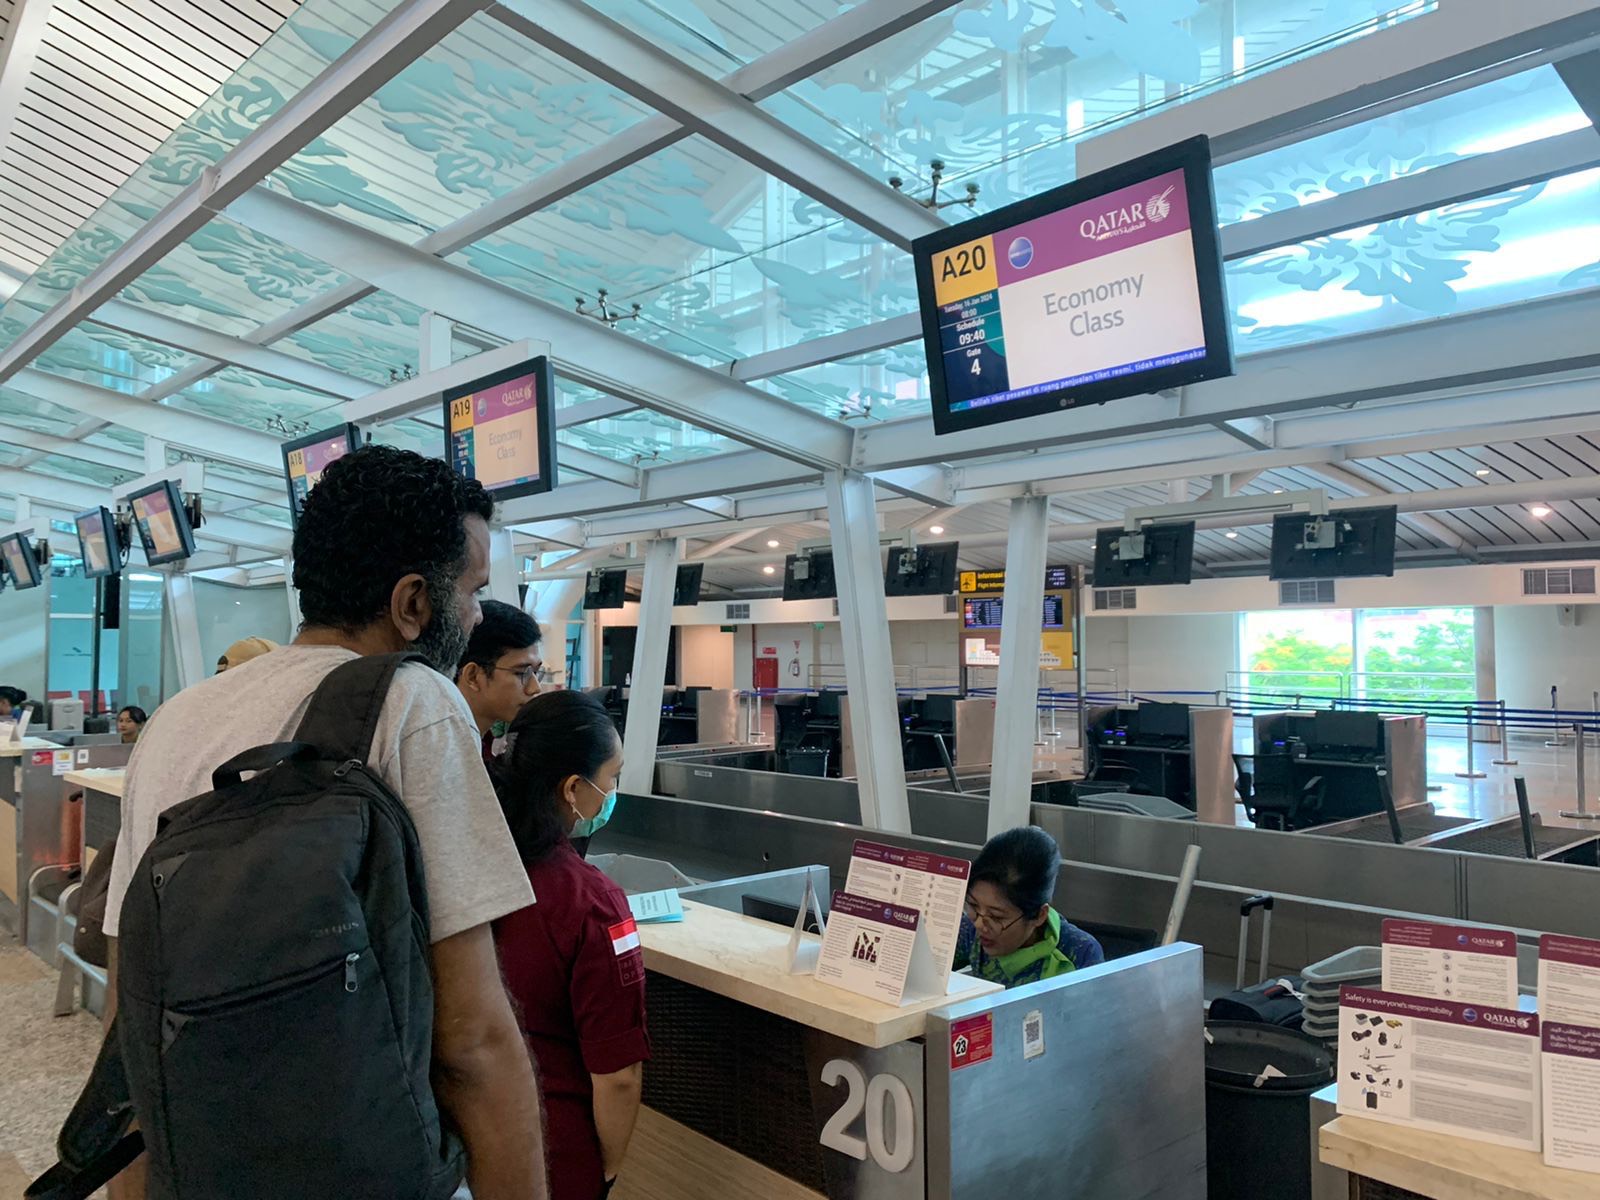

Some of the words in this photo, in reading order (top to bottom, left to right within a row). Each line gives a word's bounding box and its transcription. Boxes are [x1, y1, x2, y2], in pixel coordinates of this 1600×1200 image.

[1080, 203, 1144, 239] QATAR
[941, 244, 987, 283] A20
[1043, 273, 1144, 316] Economy
[956, 318, 985, 331] Schedule
[1070, 309, 1125, 337] Class
[959, 329, 985, 345] 09:40
[966, 348, 981, 357] Gate
[971, 358, 981, 375] 4
[1060, 375, 1094, 388] penjualan
[1135, 361, 1154, 371] tidak
[502, 388, 524, 404] QATAR
[453, 399, 471, 418] A19
[488, 429, 522, 446] Economy
[290, 452, 303, 466] A18
[496, 447, 516, 460] Class
[1471, 937, 1496, 945] QATAR
[1345, 993, 1366, 1004] Safety
[1372, 998, 1407, 1010] everyone's
[1483, 1012, 1516, 1025] QATAR
[956, 1040, 967, 1055] 23
[820, 1059, 914, 1173] 20
